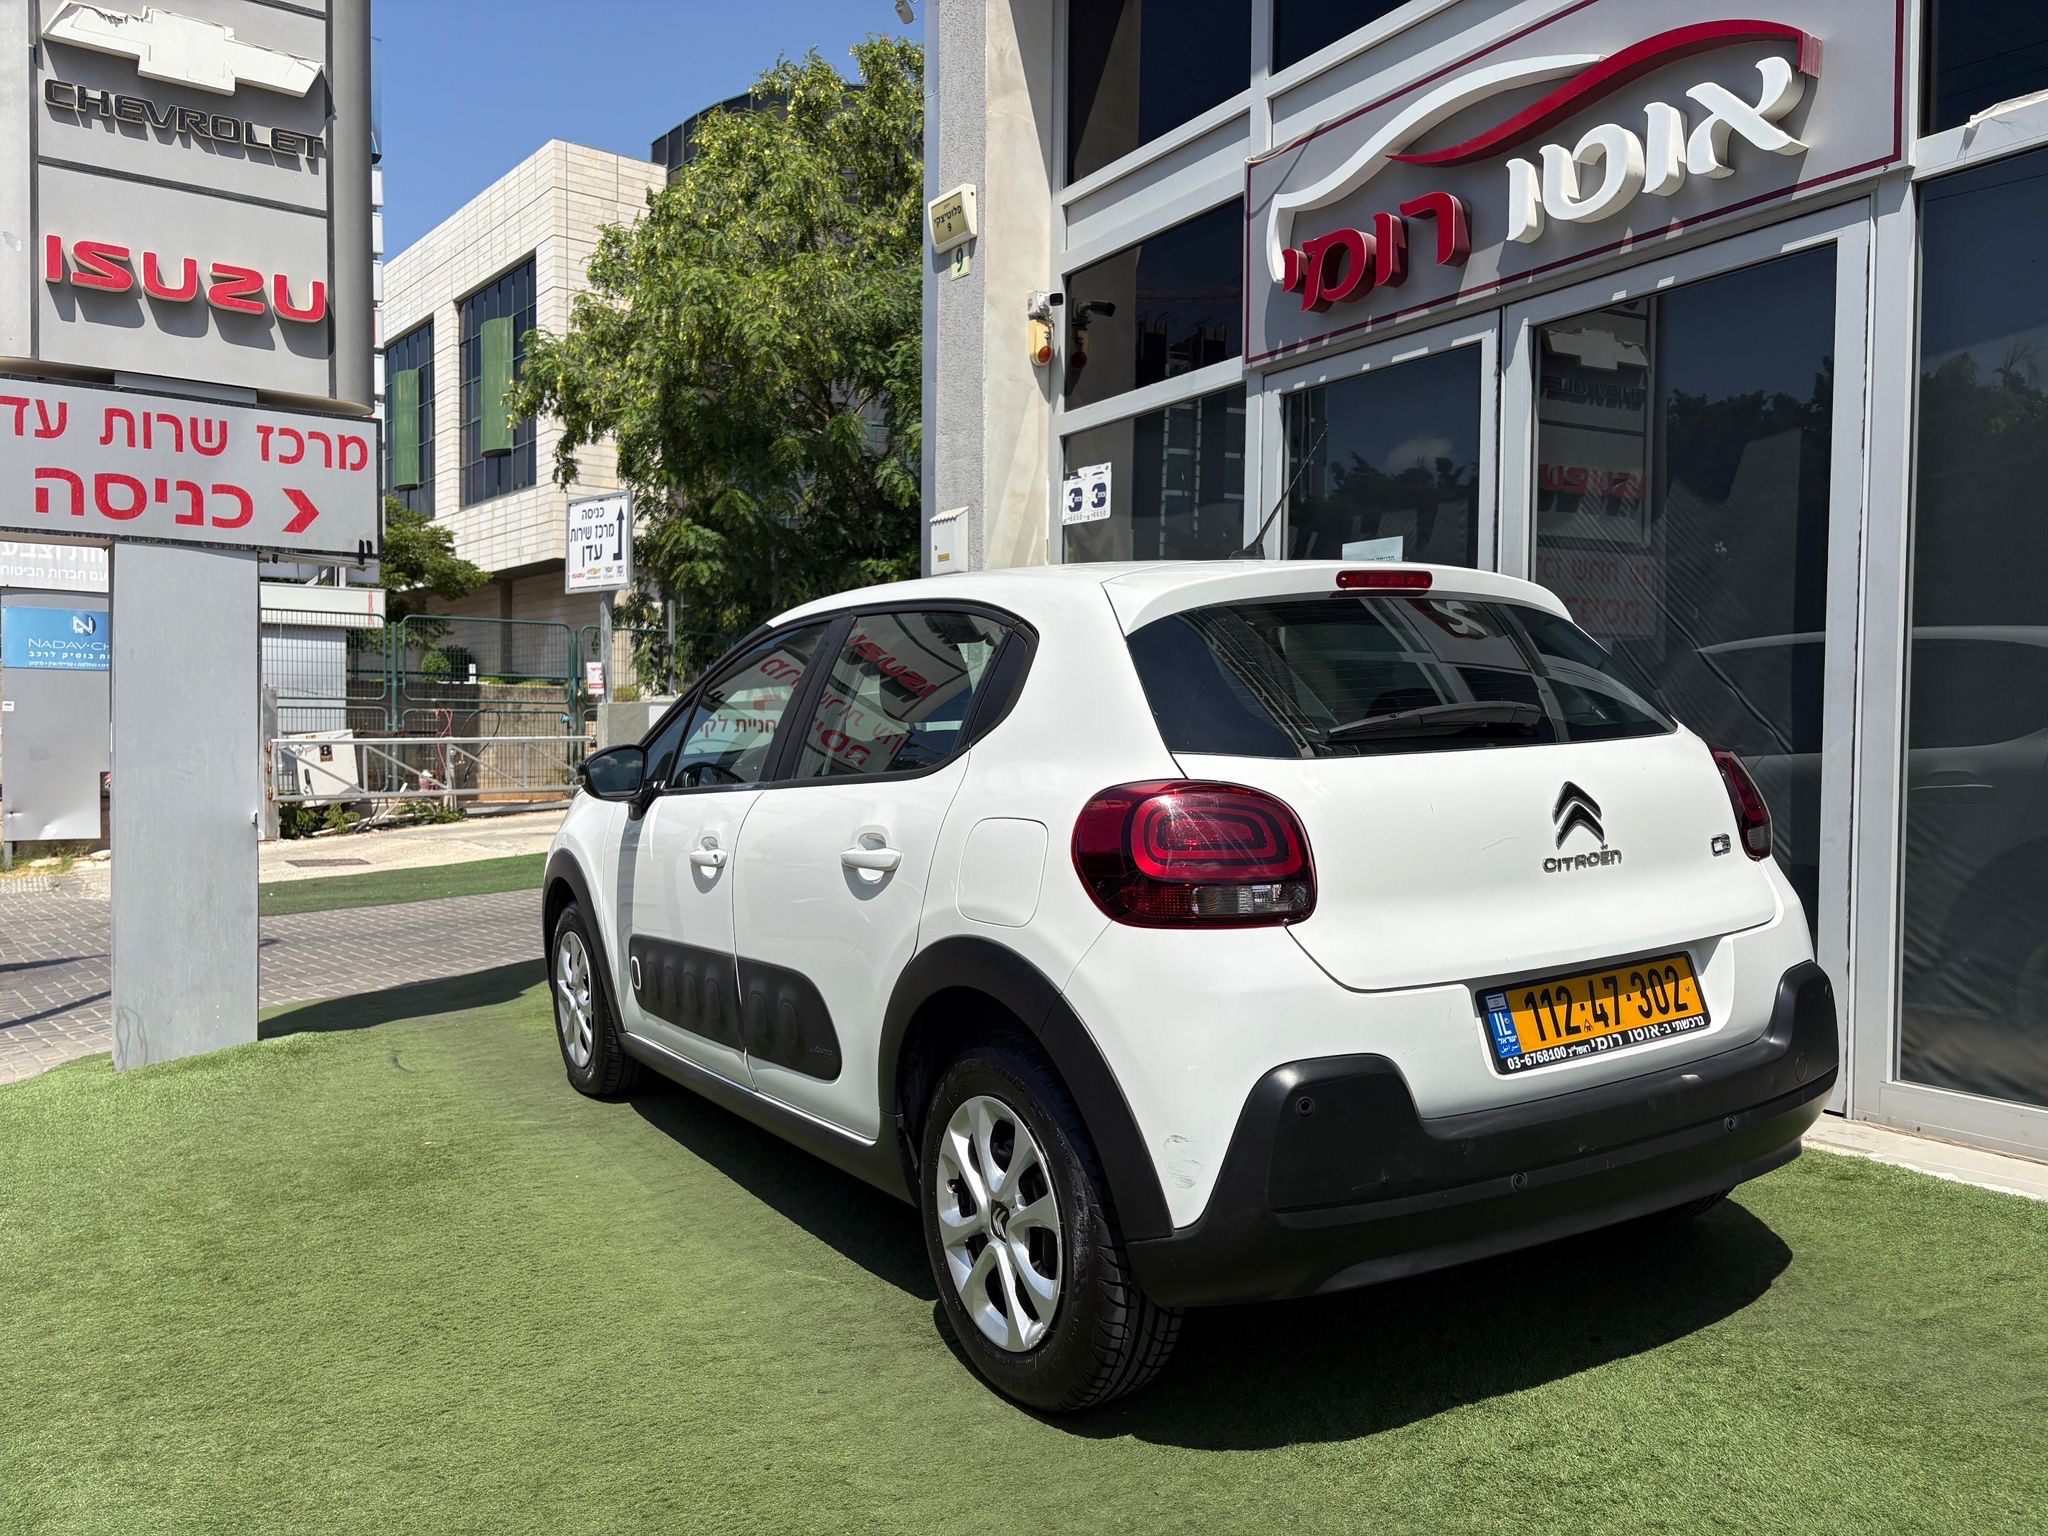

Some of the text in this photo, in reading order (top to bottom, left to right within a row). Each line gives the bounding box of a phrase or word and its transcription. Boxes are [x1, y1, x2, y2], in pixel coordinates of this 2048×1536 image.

[44, 78, 325, 159] CHEVROLET
[1281, 56, 1809, 313] אוטו רומי
[956, 247, 964, 273] 9
[45, 234, 327, 322] ISUZU
[99, 406, 229, 457] שרות
[256, 424, 369, 472] מרכז
[34, 467, 254, 529] כניסה
[582, 507, 605, 520] כניסה
[570, 523, 615, 542] מרכז שירות
[582, 544, 603, 567] עדן
[1494, 1012, 1512, 1037] IL
[1627, 1023, 1672, 1043] ב-אוטו
[1672, 1015, 1705, 1032] נרכשתי
[1498, 1035, 1518, 1045] ישראל
[1590, 1033, 1623, 1051] רומי
[1507, 1046, 1567, 1070] 03-6768100
